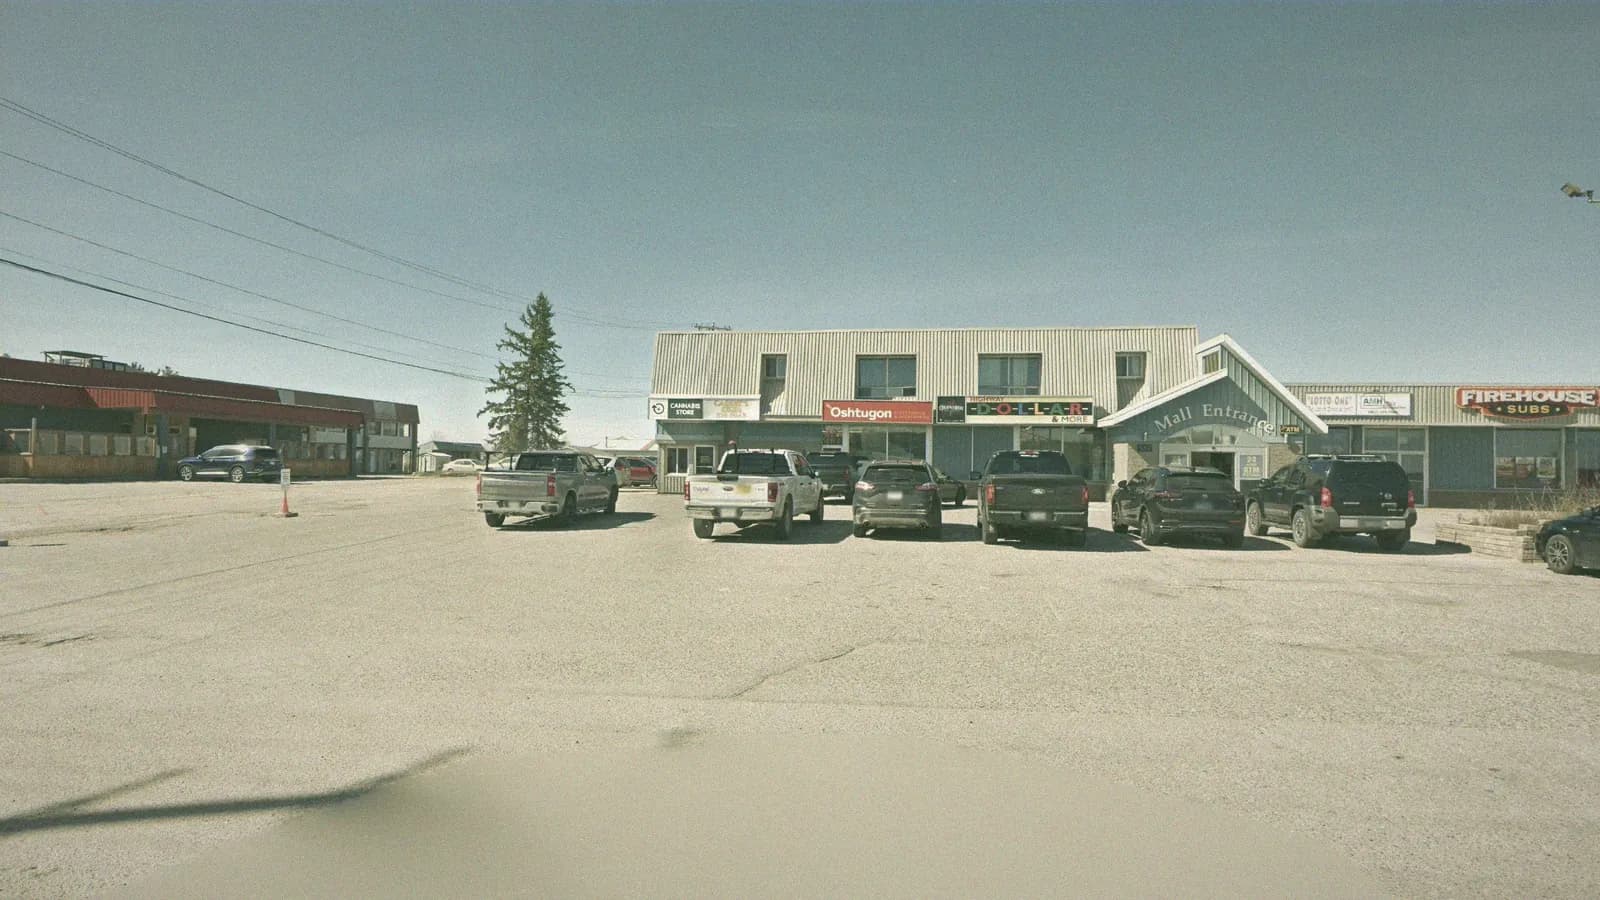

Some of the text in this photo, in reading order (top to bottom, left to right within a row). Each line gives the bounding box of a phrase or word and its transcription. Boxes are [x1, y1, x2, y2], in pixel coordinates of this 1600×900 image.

[1462, 389, 1597, 406] FIREHOUSE
[830, 406, 893, 421] Oshtugon
[1507, 404, 1551, 414] SUBS
[1060, 415, 1089, 423] MORE
[1154, 403, 1275, 435] Mall Entrance
